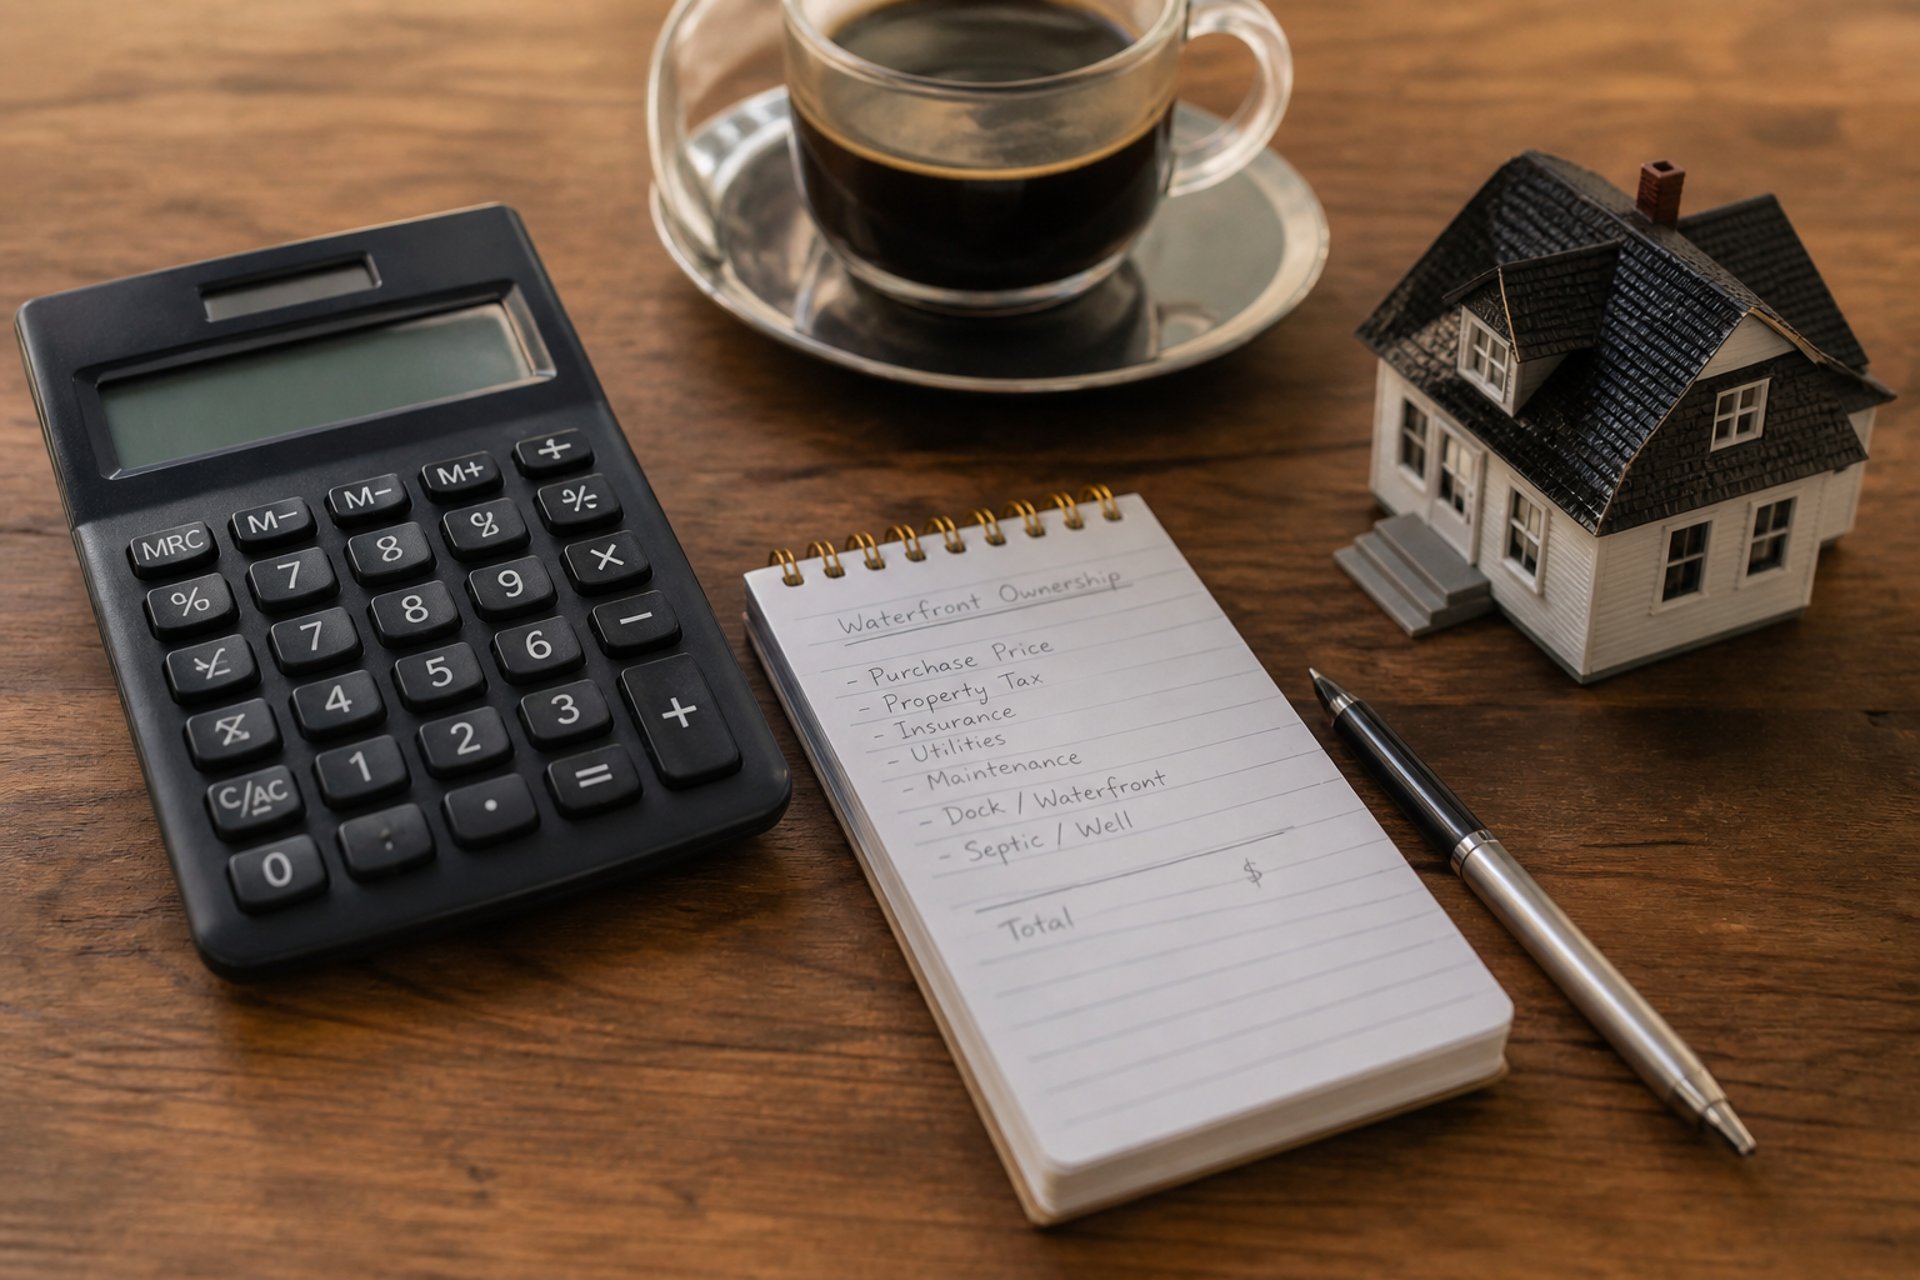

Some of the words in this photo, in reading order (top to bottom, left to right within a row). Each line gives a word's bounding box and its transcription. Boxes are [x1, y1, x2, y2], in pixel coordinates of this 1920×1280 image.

[436, 462, 484, 486] M+
[141, 529, 204, 561] MRC
[376, 535, 403, 562] 8
[277, 560, 301, 589] 7
[497, 569, 524, 597] 9
[170, 586, 210, 617] %
[401, 594, 429, 623] 8
[838, 593, 981, 635] Waterfront
[999, 569, 1121, 603] Ownership
[299, 620, 323, 651] 7
[525, 630, 552, 660] 6
[425, 656, 453, 687] 5
[868, 653, 978, 687] Purchase
[991, 638, 1054, 662] Price
[325, 684, 353, 713] 4
[882, 682, 989, 714] Property
[997, 671, 1044, 690] Tax
[551, 694, 580, 725] 3
[893, 705, 1017, 741] Insurance
[450, 722, 481, 755] 2
[910, 732, 1007, 764] Utilities
[349, 751, 372, 782] 1
[926, 751, 1082, 791] Maintenance
[219, 779, 288, 818] C/AC
[942, 801, 1006, 827] Dock
[1033, 769, 1167, 809] Waterfront
[964, 833, 1045, 865] Septic
[1075, 810, 1134, 837] Well
[262, 852, 293, 887] 0
[1243, 858, 1263, 888] $
[998, 906, 1075, 943] Total
